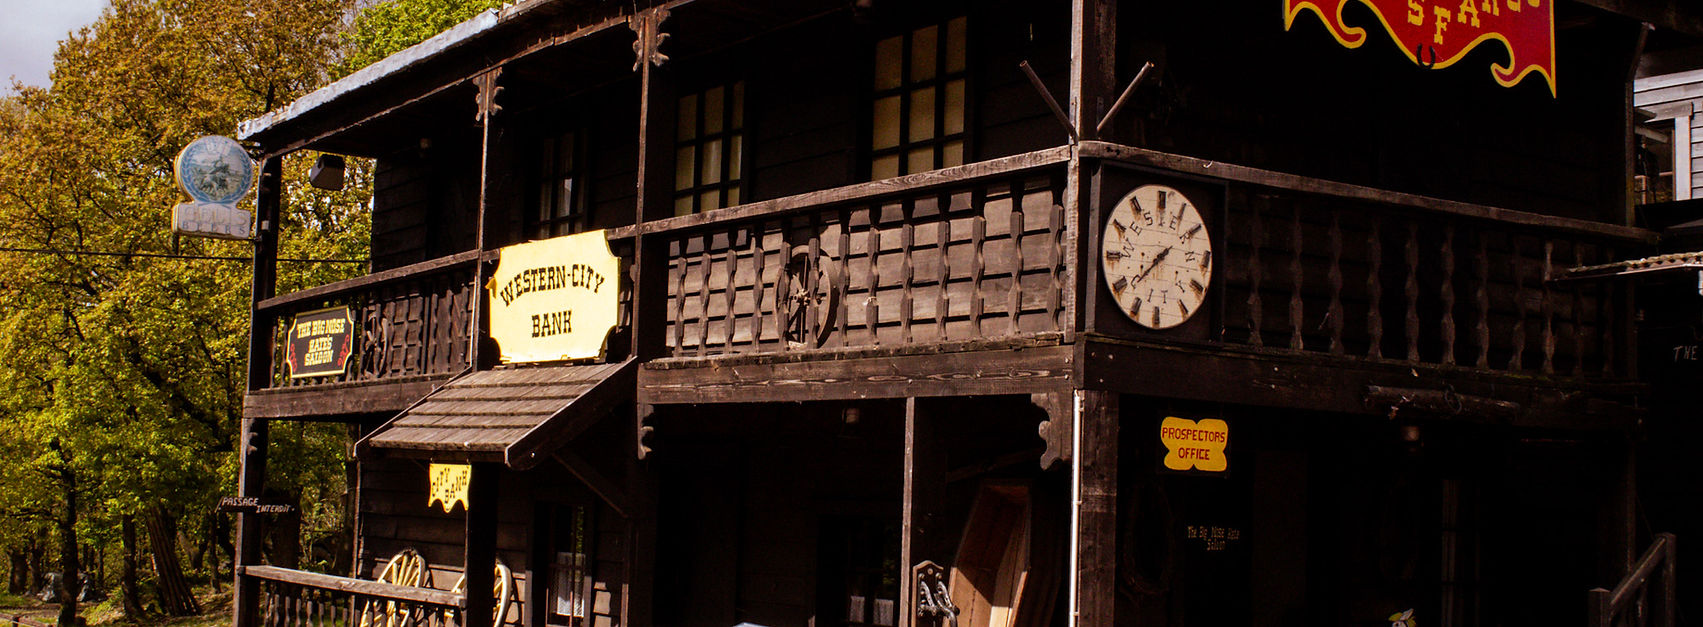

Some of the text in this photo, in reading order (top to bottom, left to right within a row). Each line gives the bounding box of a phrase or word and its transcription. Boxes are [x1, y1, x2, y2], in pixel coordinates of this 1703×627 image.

[500, 263, 605, 307] WESTERN-CITY
[297, 318, 346, 339] THE BIG NOSE
[531, 310, 573, 338] BANK
[304, 350, 334, 367] SALOON
[1673, 345, 1699, 362] THE
[1161, 427, 1226, 443] PROSPECTORS
[1178, 447, 1211, 461] OFFICE
[432, 467, 450, 497] CITY
[445, 470, 468, 504] BANK
[222, 497, 259, 507] PASSAGE
